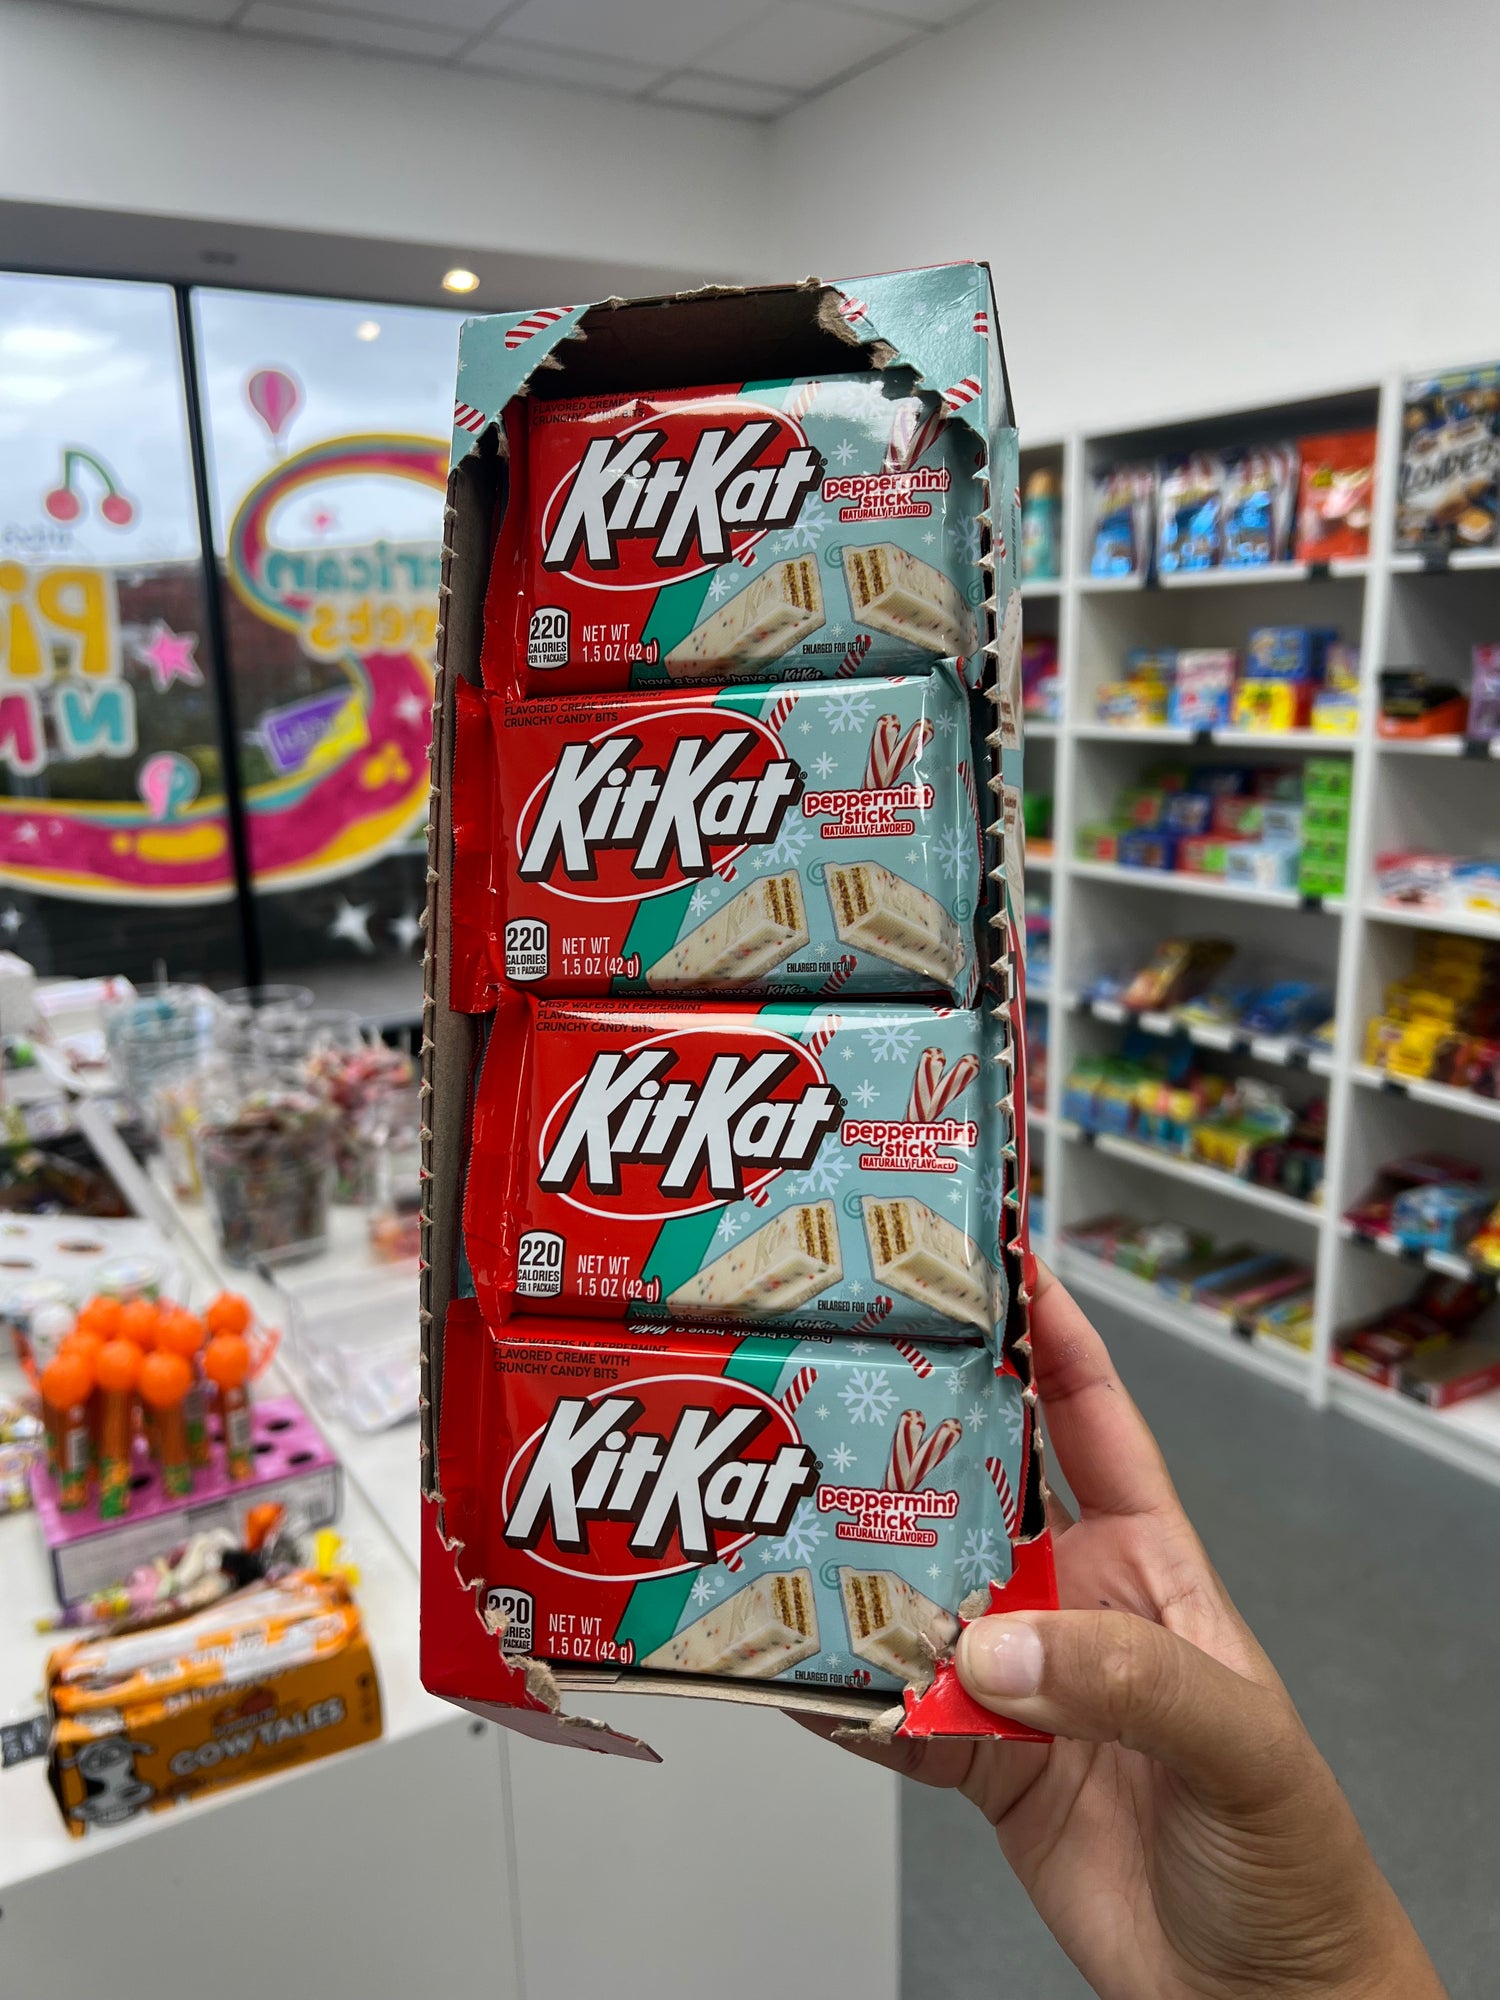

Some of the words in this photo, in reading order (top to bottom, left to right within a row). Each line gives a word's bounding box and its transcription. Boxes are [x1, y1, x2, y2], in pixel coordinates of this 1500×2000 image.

[533, 401, 586, 415] FLAVORED
[588, 398, 624, 410] CREME
[824, 468, 950, 501] peppermint
[541, 420, 825, 572] KitKat
[842, 506, 887, 521] NATURALLY
[887, 504, 929, 518] FLAVORED
[530, 614, 566, 640] 220
[582, 625, 607, 643] NET
[610, 624, 631, 641] WT
[528, 641, 567, 654] CALORIES
[582, 645, 600, 663] 1.5
[604, 644, 620, 662] OZ
[624, 642, 642, 663] (42
[645, 641, 658, 664] g)
[802, 643, 833, 655] ENLARGED
[834, 642, 846, 653] FOR
[847, 641, 868, 653] DETAIL
[528, 654, 537, 664] PER
[543, 653, 567, 663] PACKAGE
[638, 677, 672, 686] have
[731, 673, 766, 683] have
[504, 703, 558, 716] FLAVORED
[504, 715, 554, 728] CRUNCHY
[556, 713, 593, 725] CANDY
[595, 711, 618, 722] BITS
[517, 729, 805, 882] KitKat
[804, 785, 933, 815] peppermint
[844, 806, 893, 825] stick
[823, 824, 869, 836] NATURALLY
[870, 822, 911, 834] FLAVORED
[506, 926, 545, 952] 220
[562, 937, 586, 955] NET
[590, 936, 610, 954] WT
[505, 954, 546, 966] CALORIES
[562, 958, 580, 976] 1.5
[584, 957, 601, 975] OZ
[604, 956, 624, 978] (42
[627, 954, 640, 978] g)
[786, 962, 817, 973] ENLARGED
[818, 962, 831, 973] FOR
[832, 961, 854, 972] DETAIL
[506, 966, 516, 975] PER
[521, 965, 546, 975] PACKAGE
[537, 1000, 570, 1009] CRISP
[571, 1001, 616, 1009] WAFERS
[617, 1002, 631, 1010] IN
[632, 1001, 702, 1011] PEPPERMINT
[536, 1021, 589, 1033] CRUNCHY
[590, 1022, 628, 1033] CANDY
[631, 1025, 655, 1033] BITS
[536, 1046, 845, 1200] KitKat
[884, 1140, 934, 1158] stick
[862, 1157, 910, 1169] NATURALLY
[519, 1240, 560, 1267] 220
[577, 1254, 604, 1274] NET
[608, 1255, 630, 1275] WT
[517, 1269, 560, 1282] CALORIES
[532, 1282, 559, 1293] PACKAGE
[576, 1277, 597, 1297] 1.5
[600, 1277, 618, 1297] OZ
[621, 1278, 643, 1300] (42
[646, 1278, 660, 1303] g)
[817, 1299, 850, 1312] ENLARGED
[851, 1301, 865, 1313] FOR
[867, 1301, 889, 1314] DETAIL
[675, 1326, 686, 1334] a
[688, 1327, 726, 1337] have
[779, 1332, 791, 1340] a
[793, 1332, 831, 1343] have
[494, 1348, 552, 1361] FLAVORED
[555, 1351, 596, 1364] CREME
[599, 1354, 631, 1366] WITH
[494, 1361, 548, 1374] CRUNCHY
[550, 1365, 591, 1377] CANDY
[593, 1368, 619, 1379] BITS
[502, 1396, 821, 1564] KitKat
[819, 1486, 958, 1516] peppermint
[862, 1510, 913, 1530] stick
[839, 1525, 889, 1540] NATURALLY
[889, 1529, 935, 1544] FLAVORED
[548, 1613, 576, 1633] NET
[580, 1616, 602, 1636] WT
[503, 1638, 531, 1650] PACKAGE
[548, 1636, 569, 1654] 1.5
[573, 1638, 591, 1657] OZ
[595, 1638, 616, 1661] (42
[620, 1641, 634, 1664] g)
[794, 1670, 828, 1682] ENLARGED
[829, 1673, 843, 1684] FOR
[844, 1675, 867, 1686] DETAIL
